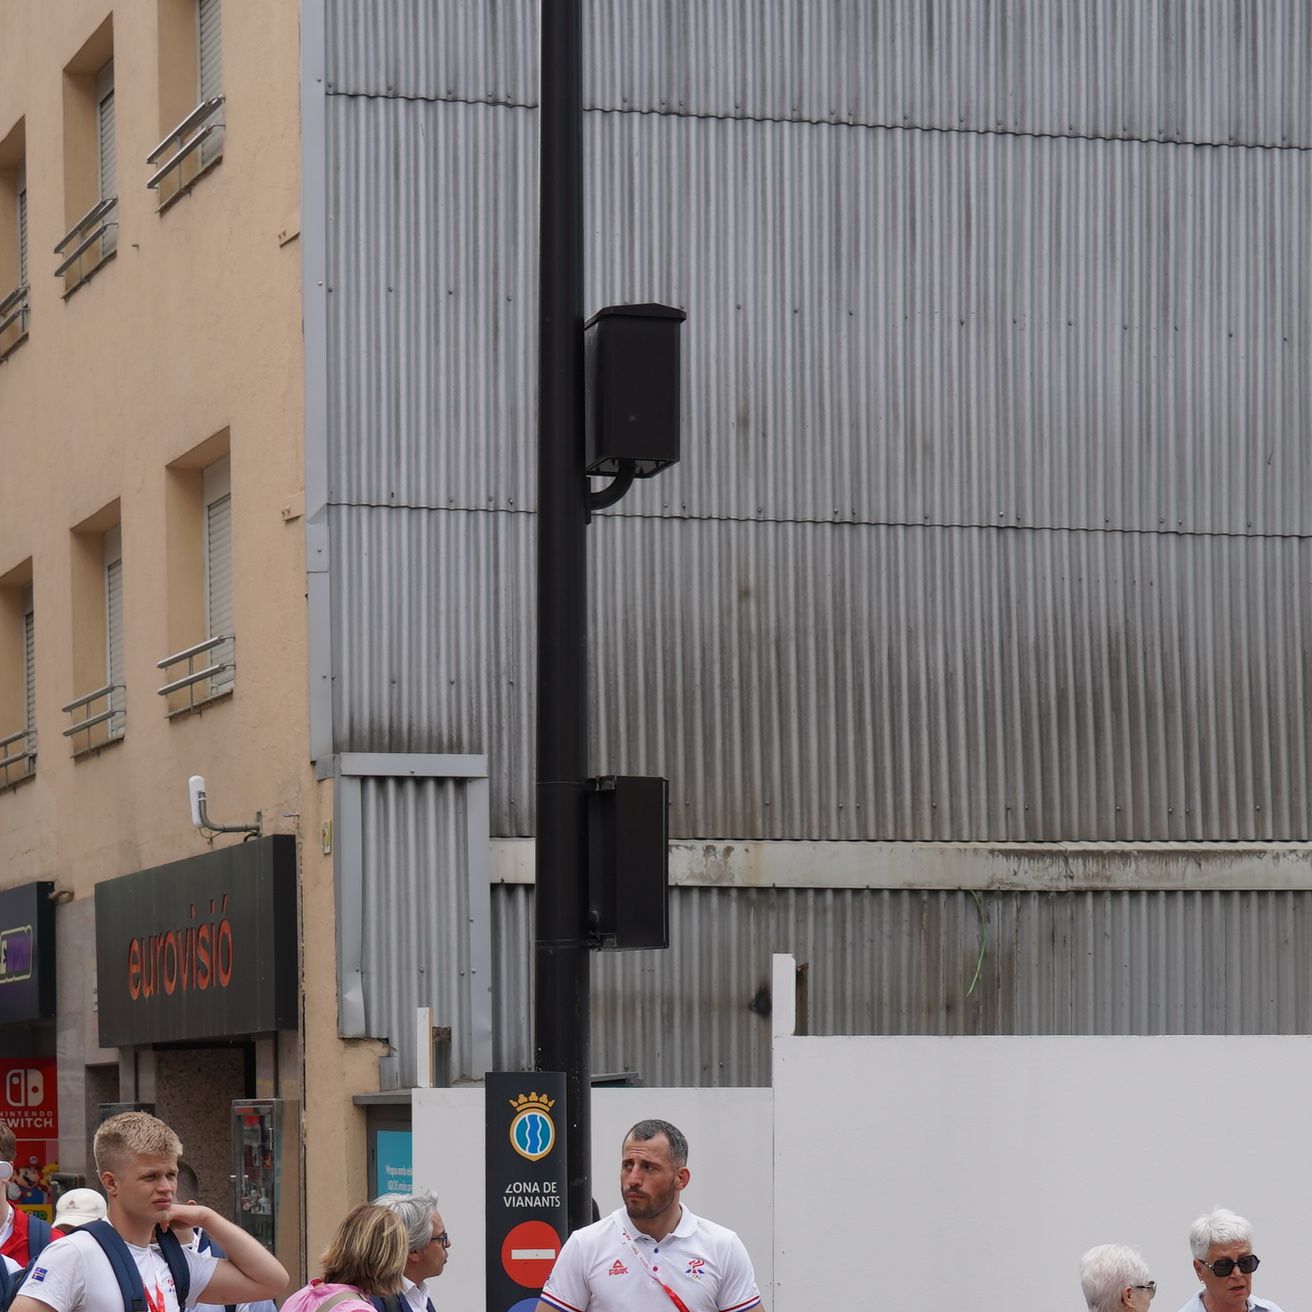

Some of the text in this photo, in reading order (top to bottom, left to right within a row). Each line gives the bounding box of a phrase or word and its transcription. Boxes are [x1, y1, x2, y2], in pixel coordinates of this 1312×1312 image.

[129, 893, 233, 1001] eurovisió
[505, 1181, 557, 1193] ZONA DE
[503, 1195, 561, 1207] VIANANTS
